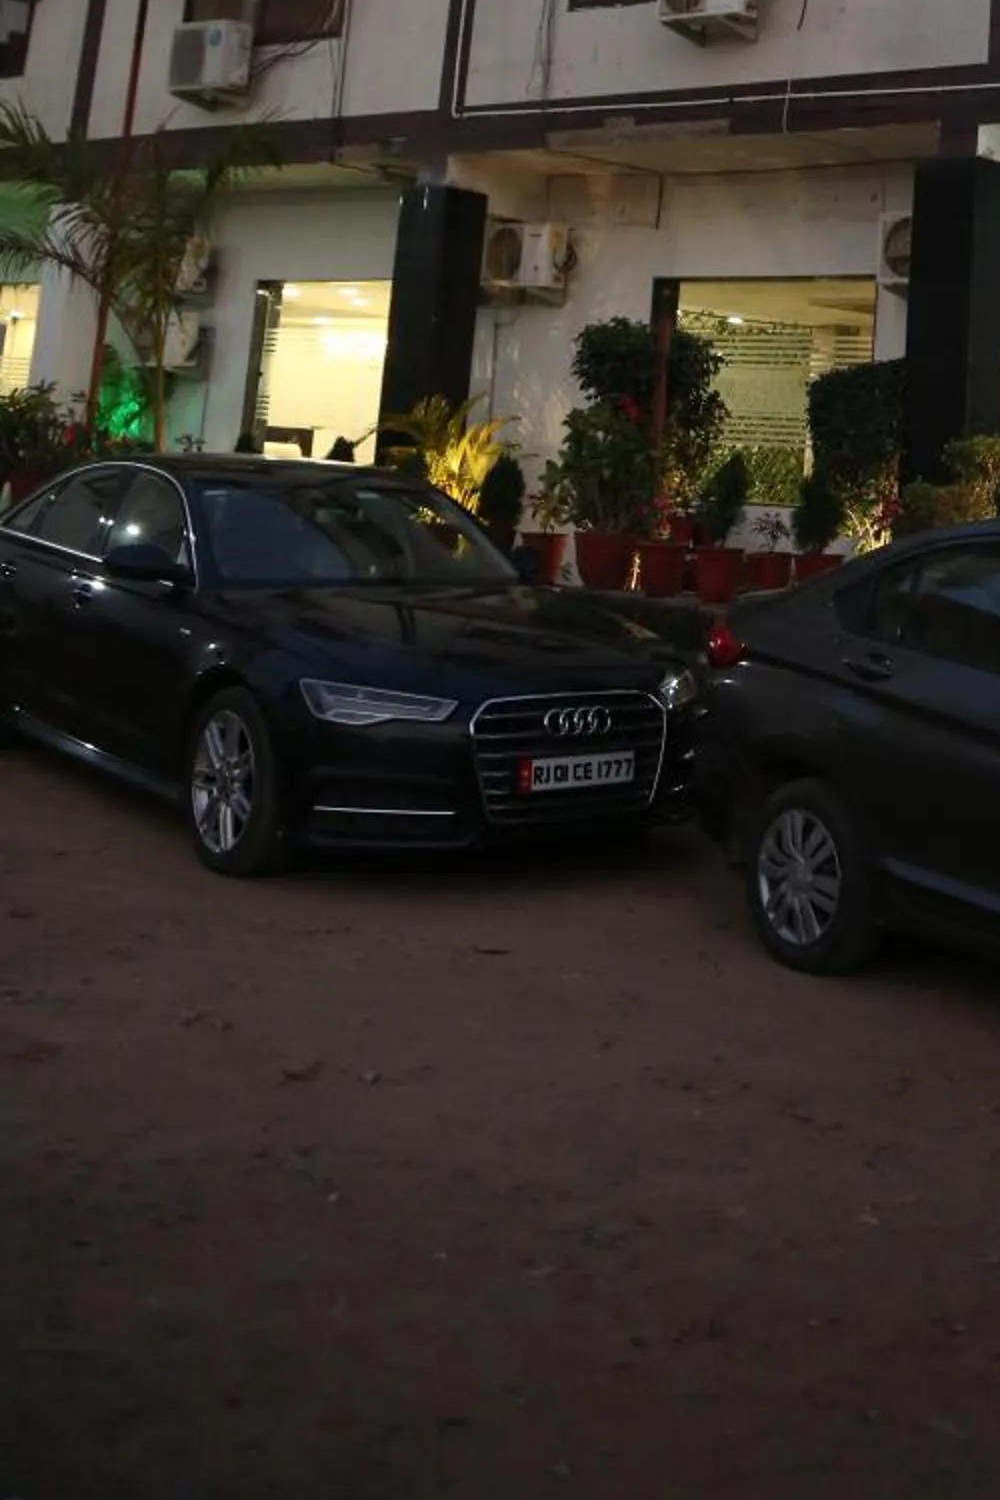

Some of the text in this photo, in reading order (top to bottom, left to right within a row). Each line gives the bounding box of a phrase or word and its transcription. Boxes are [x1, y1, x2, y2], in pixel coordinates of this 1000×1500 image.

[533, 763, 550, 784] RJ
[573, 762, 592, 780] CE
[597, 758, 632, 778] 1777
